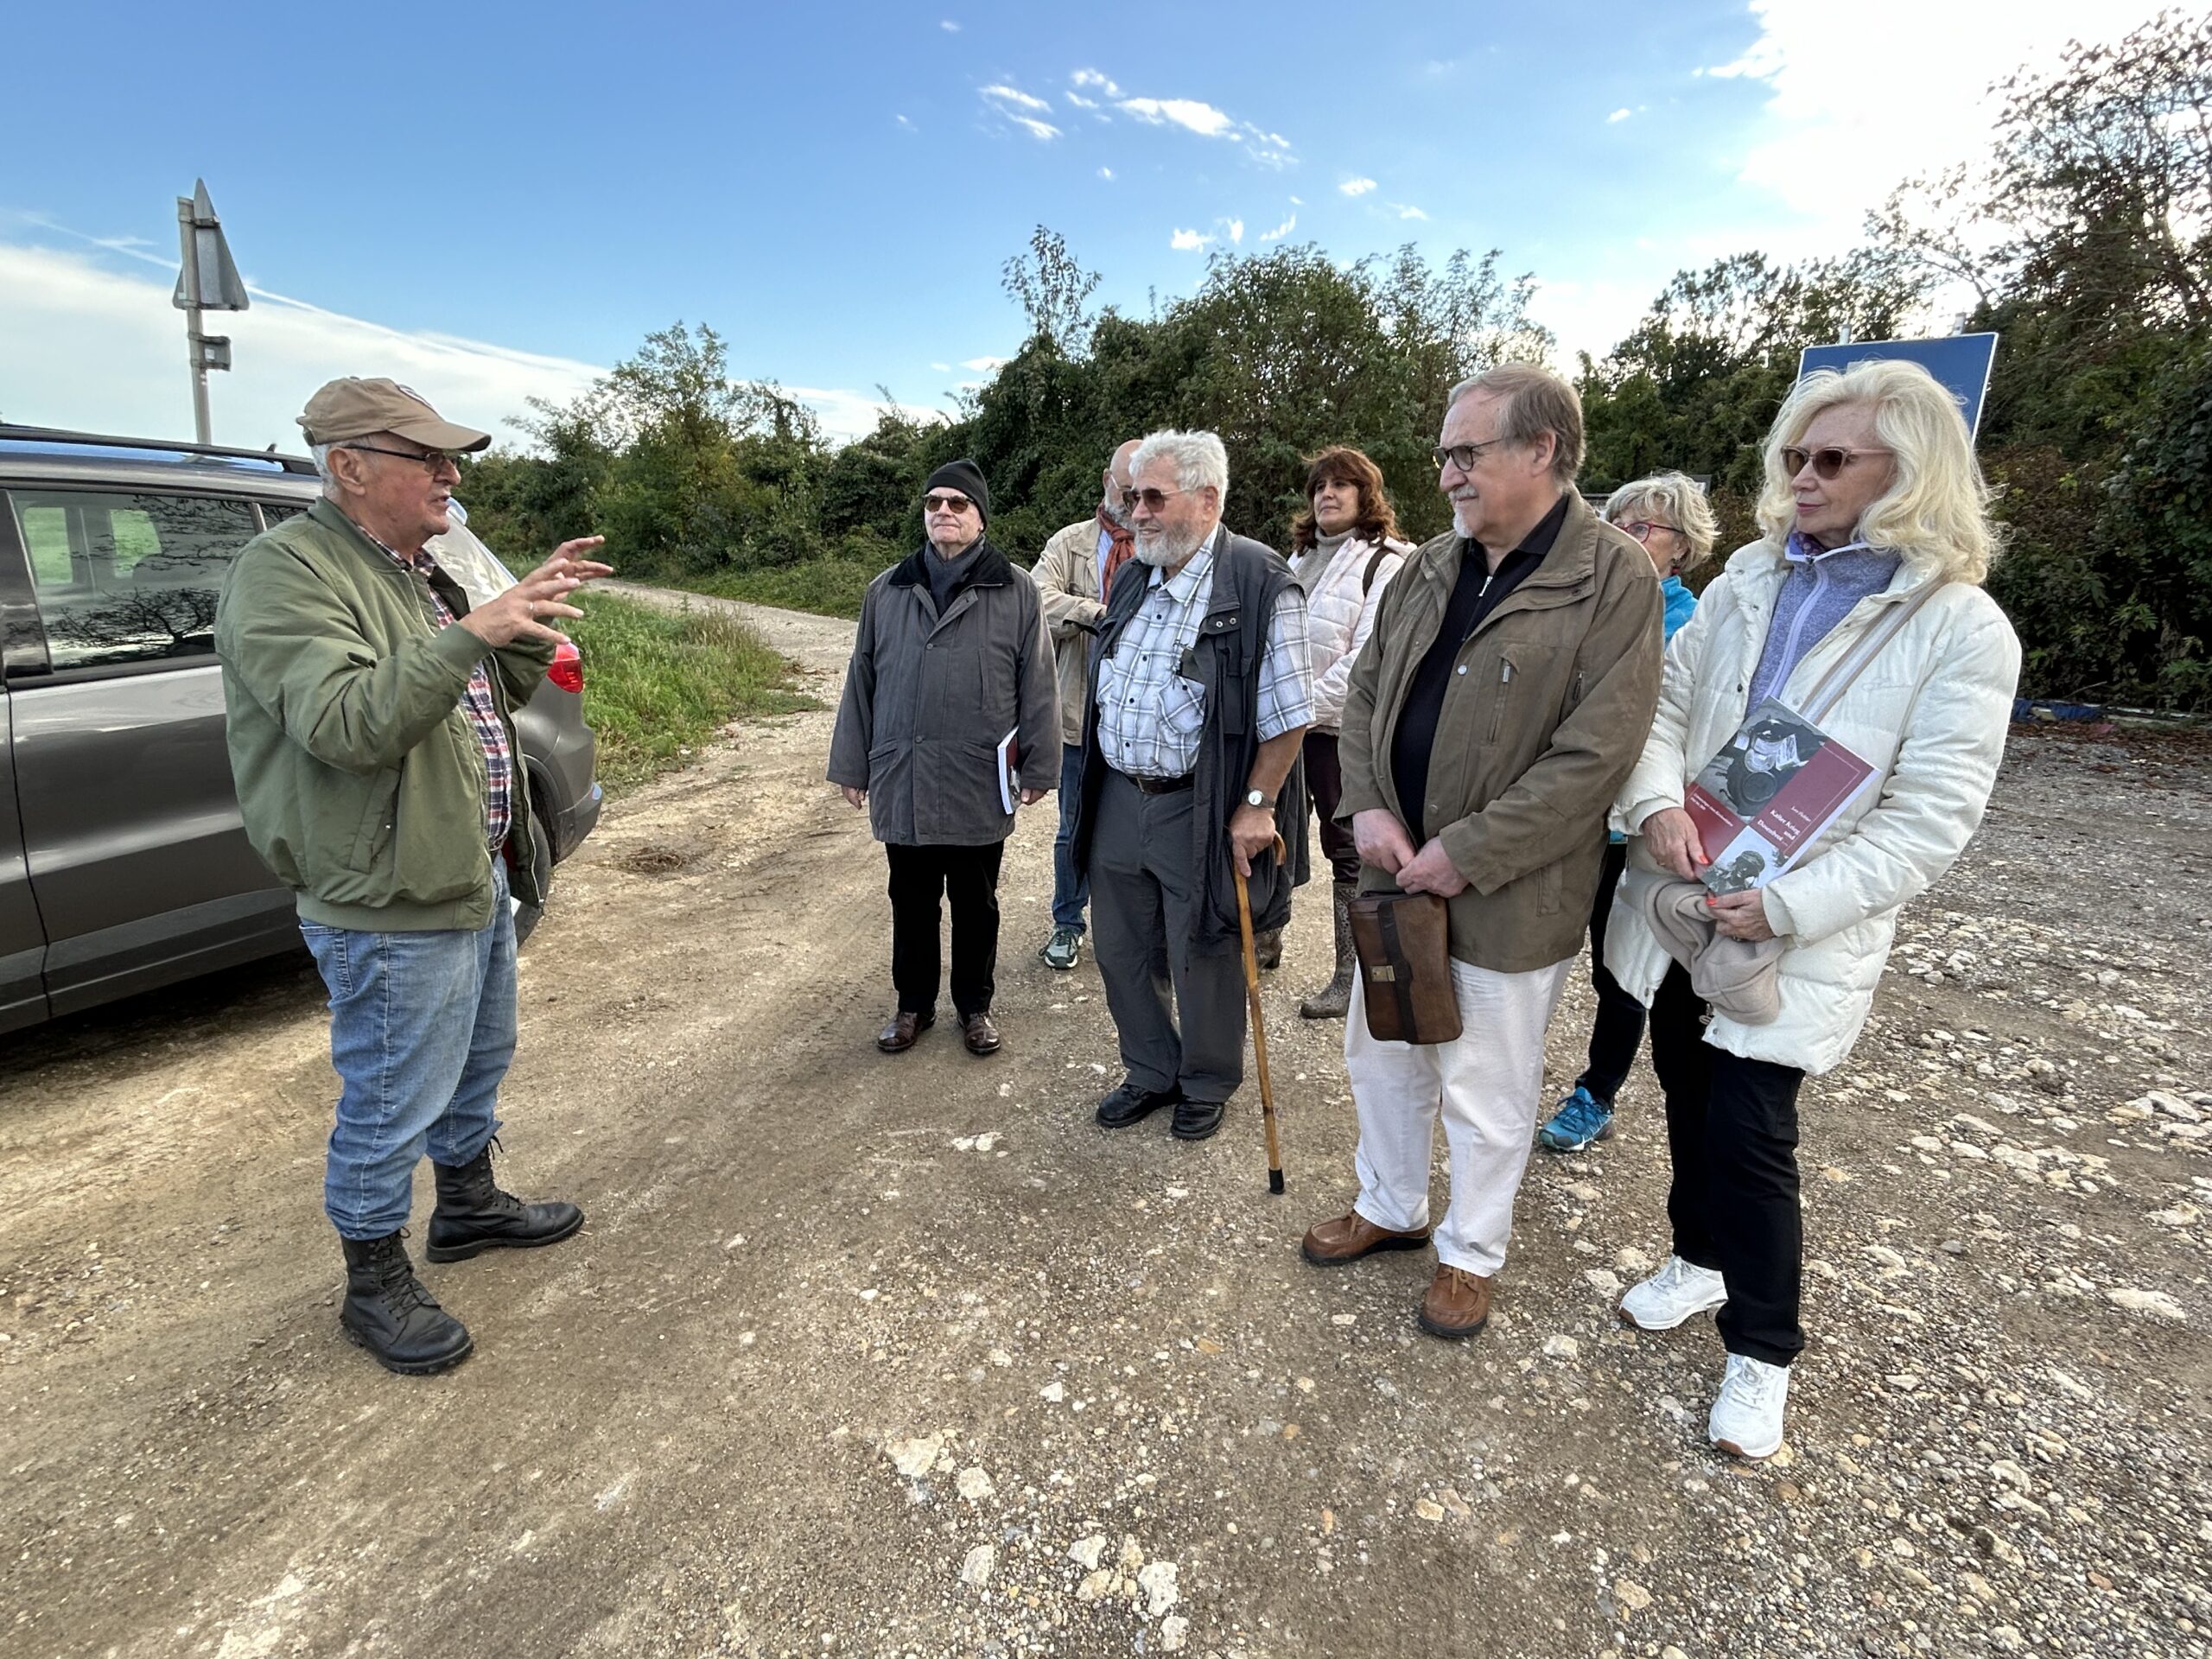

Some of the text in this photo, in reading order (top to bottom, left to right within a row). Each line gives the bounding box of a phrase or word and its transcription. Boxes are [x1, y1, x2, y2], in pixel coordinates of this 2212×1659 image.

[1770, 809, 1801, 836] Kalter Krieg
[1783, 831, 1796, 840] und
